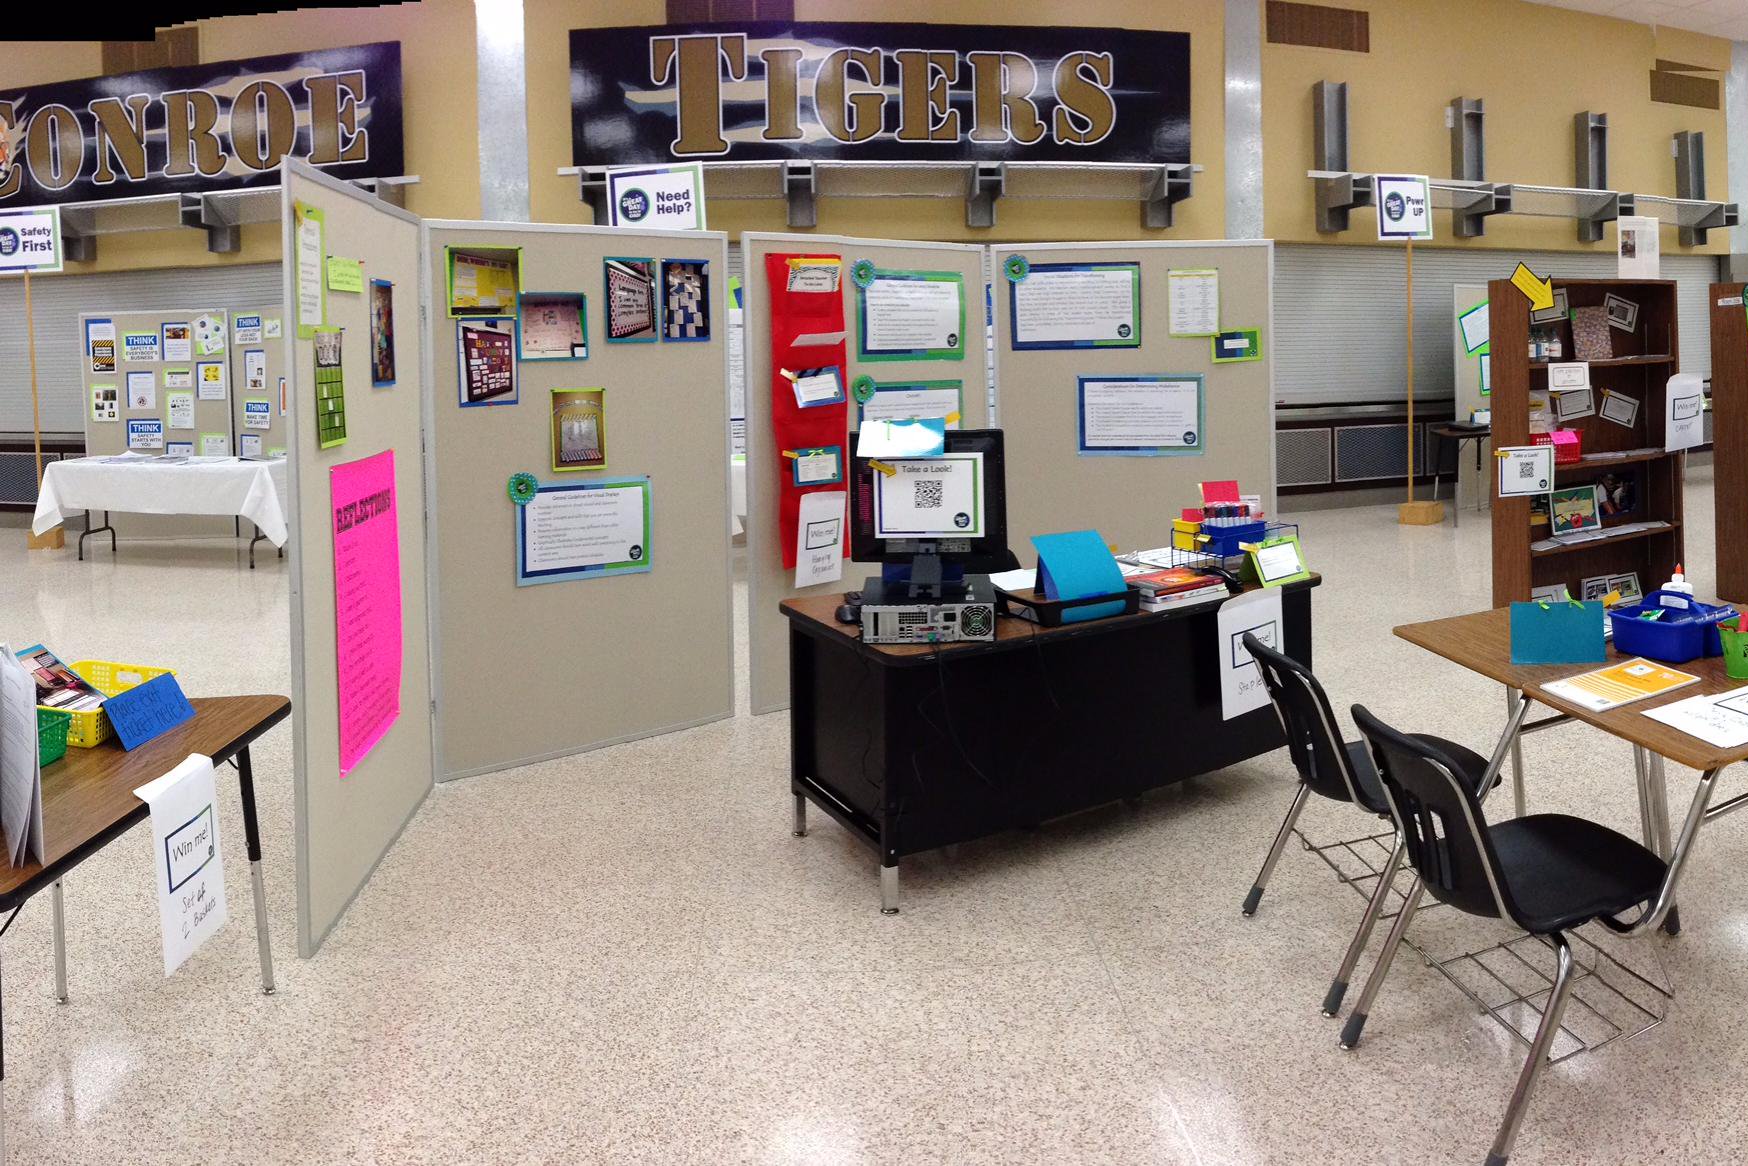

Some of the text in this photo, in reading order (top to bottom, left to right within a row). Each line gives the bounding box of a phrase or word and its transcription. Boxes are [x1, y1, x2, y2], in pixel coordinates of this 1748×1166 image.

[649, 32, 1117, 157] TIGERS
[656, 189, 690, 203] Need
[656, 201, 692, 215] Help?
[1412, 207, 1424, 217] UP
[20, 226, 52, 237] Safety
[22, 240, 53, 252] First
[238, 318, 259, 327] THINK
[127, 336, 155, 345] THINK
[247, 403, 269, 412] THINK
[132, 424, 159, 432] THINK
[901, 465, 921, 473] Take
[930, 465, 952, 473] Look!
[335, 487, 391, 535] REFLECTIONS
[172, 821, 209, 862] Win me!
[182, 890, 196, 914] Set
